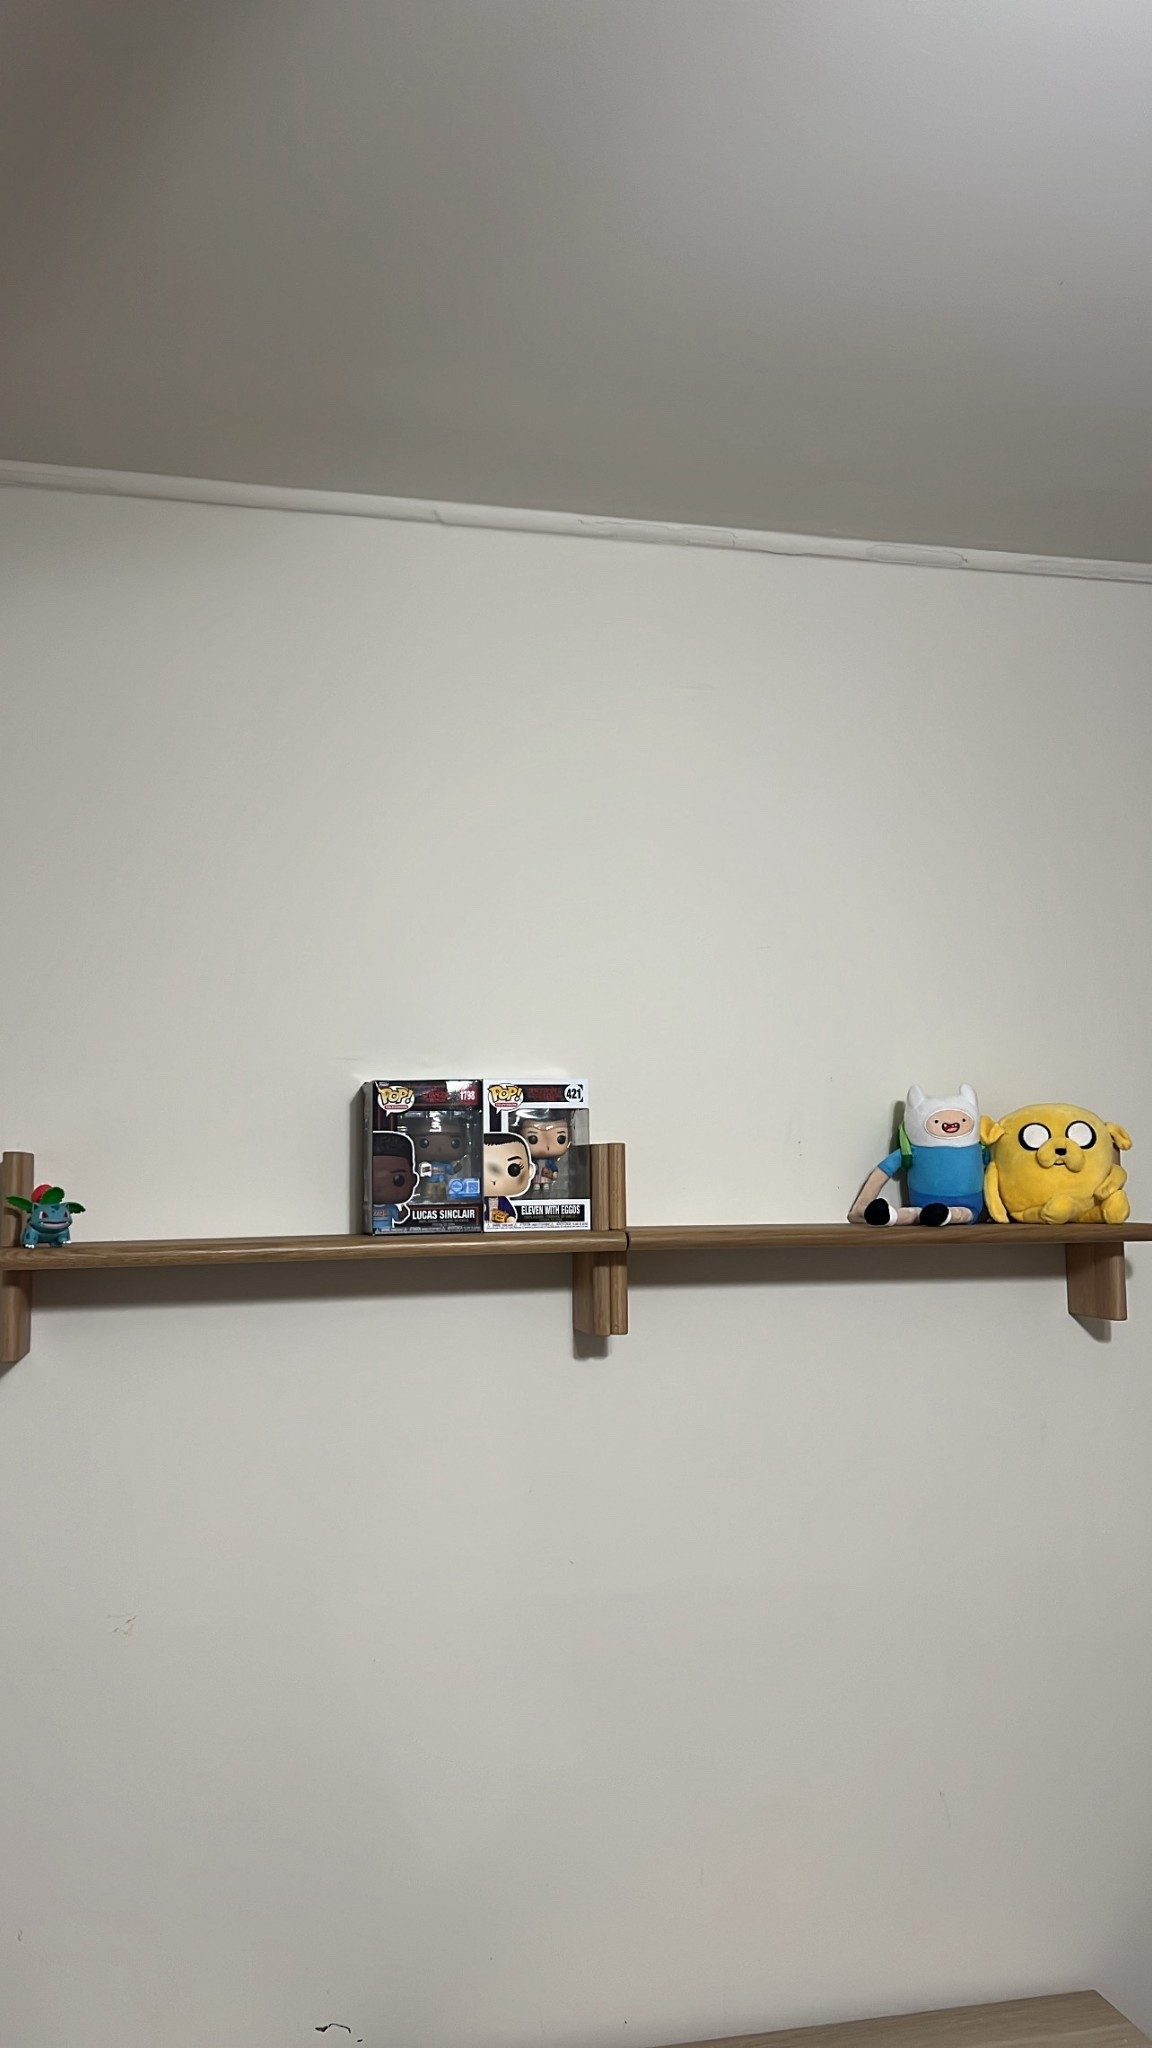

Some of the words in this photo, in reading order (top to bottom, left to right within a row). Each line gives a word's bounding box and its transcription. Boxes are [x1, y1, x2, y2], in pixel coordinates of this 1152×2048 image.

[380, 1087, 414, 1105] POP!
[460, 1090, 476, 1101] 1798
[488, 1085, 523, 1103] POP!
[566, 1088, 581, 1099] 421
[412, 1210, 438, 1220] LUCAS
[439, 1209, 476, 1219] SINCLAIR
[521, 1205, 544, 1215] ELEVEN
[544, 1204, 560, 1215] WITH
[561, 1204, 581, 1215] EGGOS
